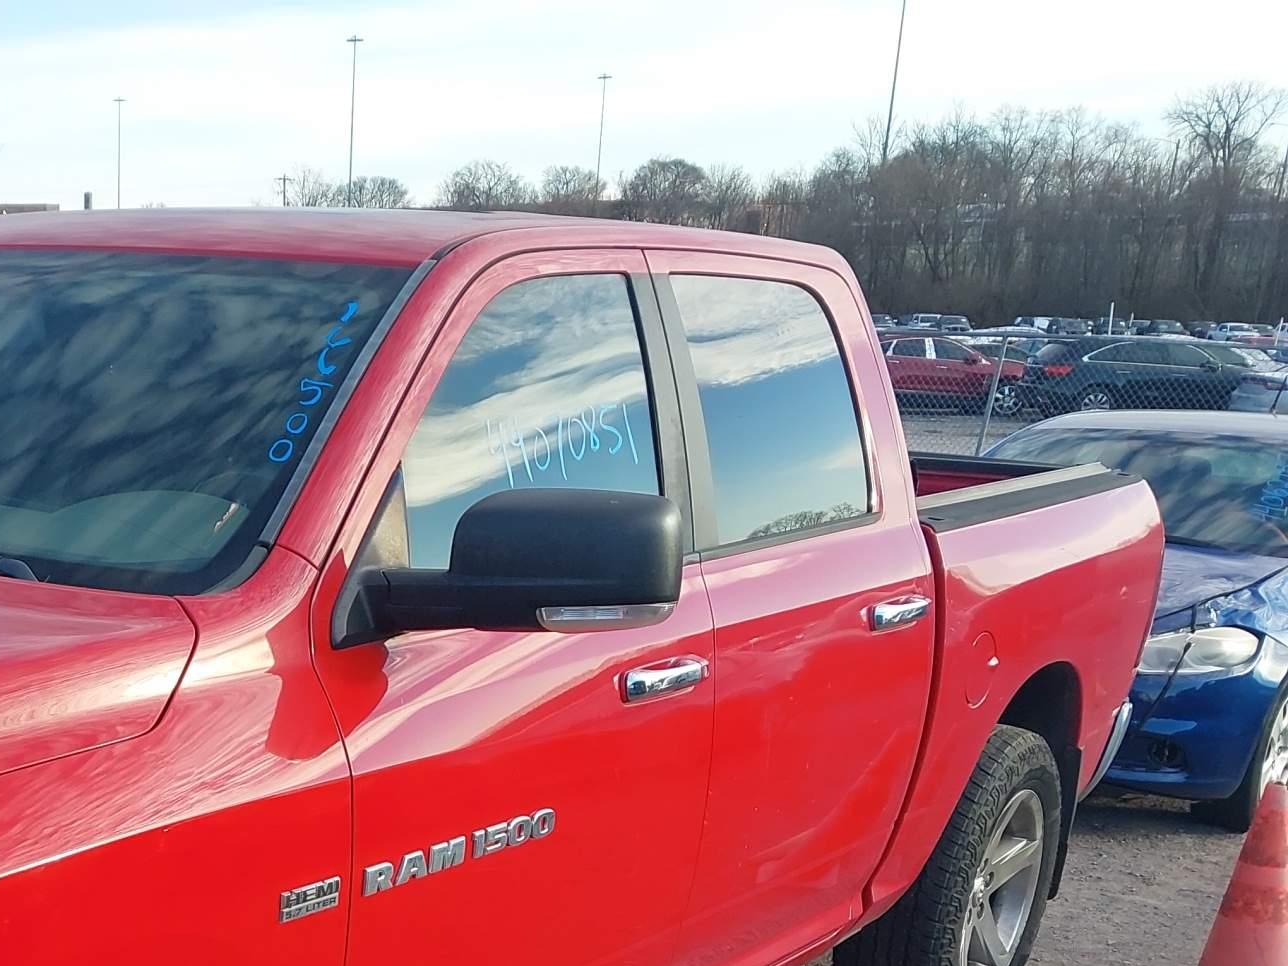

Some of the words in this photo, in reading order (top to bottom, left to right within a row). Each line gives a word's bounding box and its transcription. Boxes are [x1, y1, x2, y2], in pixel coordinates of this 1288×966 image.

[362, 836, 466, 897] RAM
[472, 808, 556, 859] 1500
[280, 876, 341, 909] HEMI
[305, 896, 337, 913] LITER
